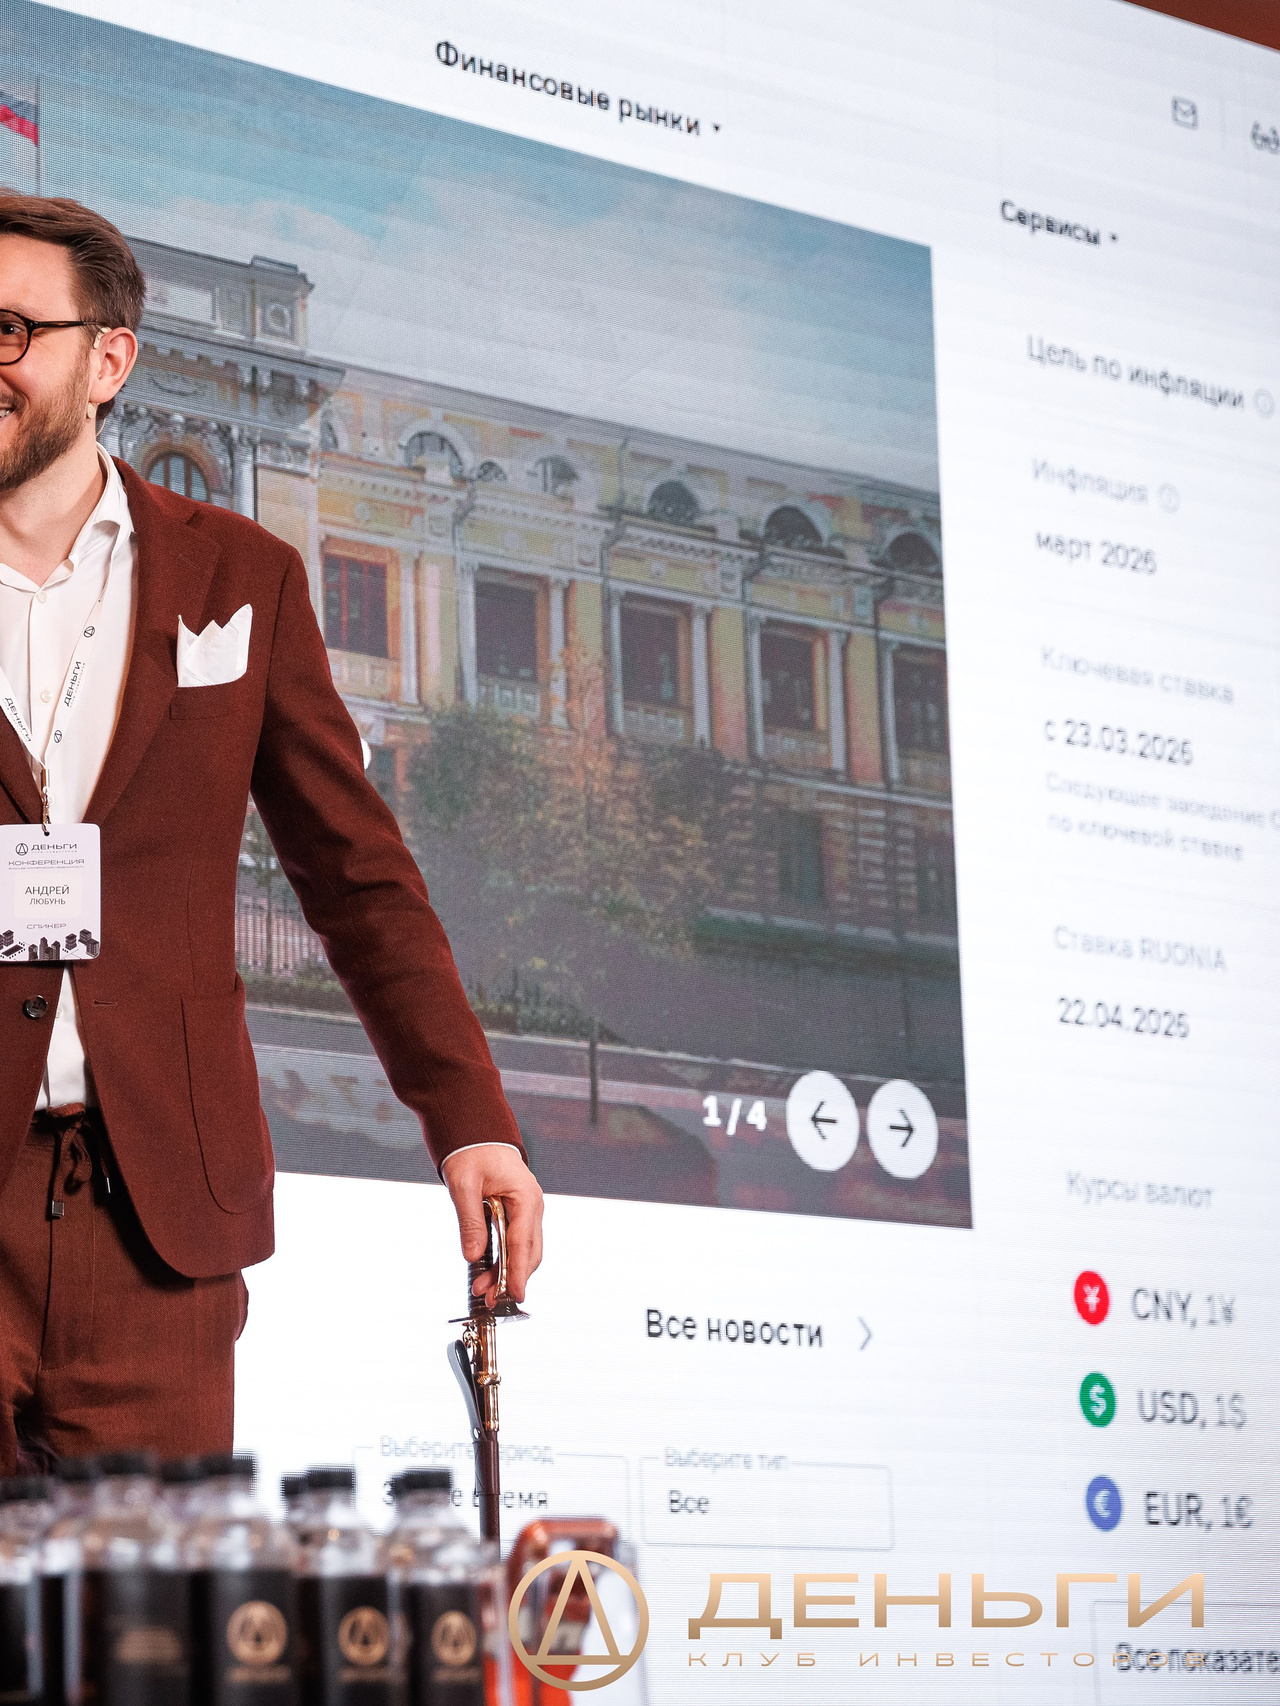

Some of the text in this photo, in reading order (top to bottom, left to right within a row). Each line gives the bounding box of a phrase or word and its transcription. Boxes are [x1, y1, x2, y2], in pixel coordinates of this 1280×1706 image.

[434, 39, 701, 138] Финансовые рынки
[1000, 199, 1101, 247] Сервисы
[1027, 333, 1245, 412] Цель по инфляции
[1032, 457, 1149, 505] Инфляция
[1035, 531, 1158, 577] март 2026
[63, 661, 82, 707] ДЕНЬГИ
[1063, 717, 1195, 766] 23.03.2026
[31, 843, 77, 851] ДЕНЬГИ
[24, 884, 70, 896] АНДРЕЙ
[703, 1094, 768, 1136] 1/4
[1066, 1169, 1215, 1209] Курсы валют
[646, 1308, 824, 1348] Все новости
[1137, 1389, 1207, 1430] USD,
[669, 1489, 709, 1514] Все
[1144, 1491, 1213, 1532] EUR,
